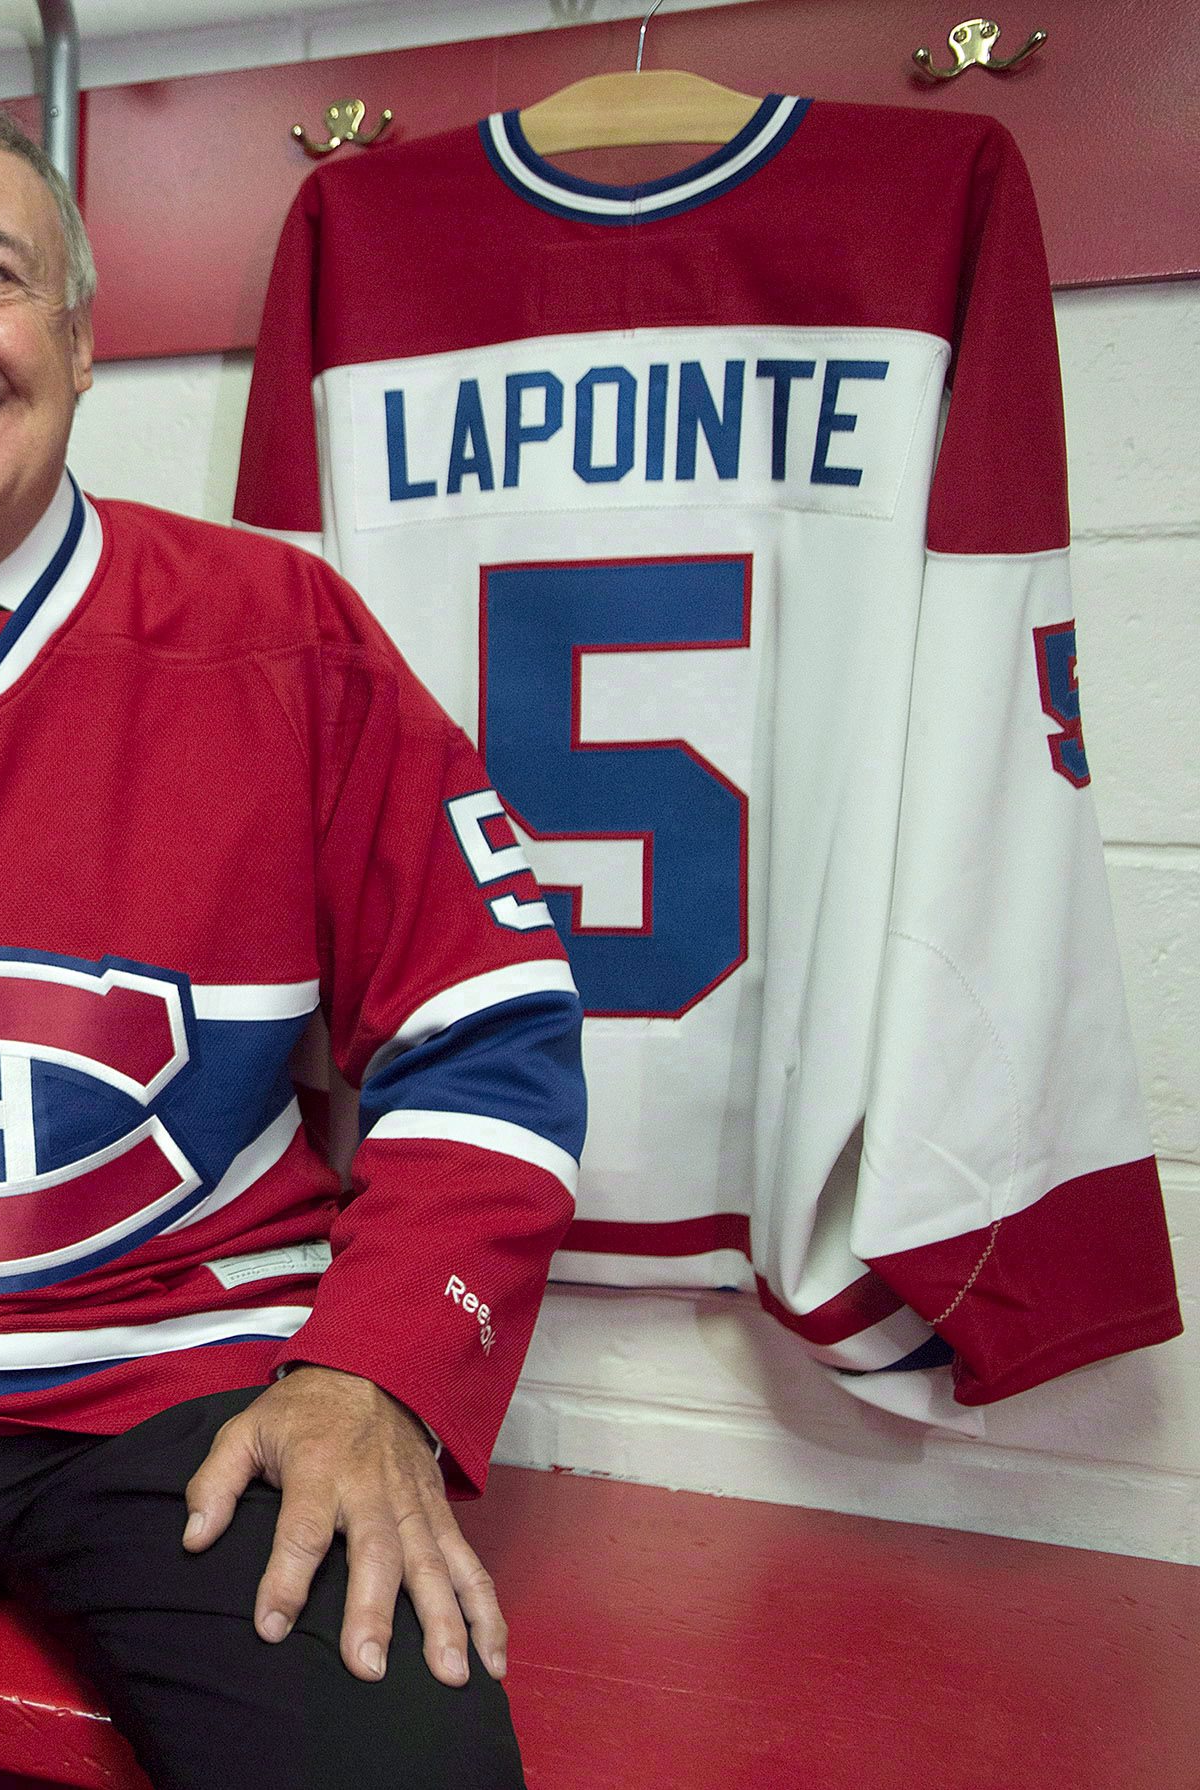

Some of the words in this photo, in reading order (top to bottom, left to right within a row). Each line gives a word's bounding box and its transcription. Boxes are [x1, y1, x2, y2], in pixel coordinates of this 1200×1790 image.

[383, 358, 890, 502] LAPOINTE
[477, 553, 753, 1020] 5
[443, 787, 556, 934] 5
